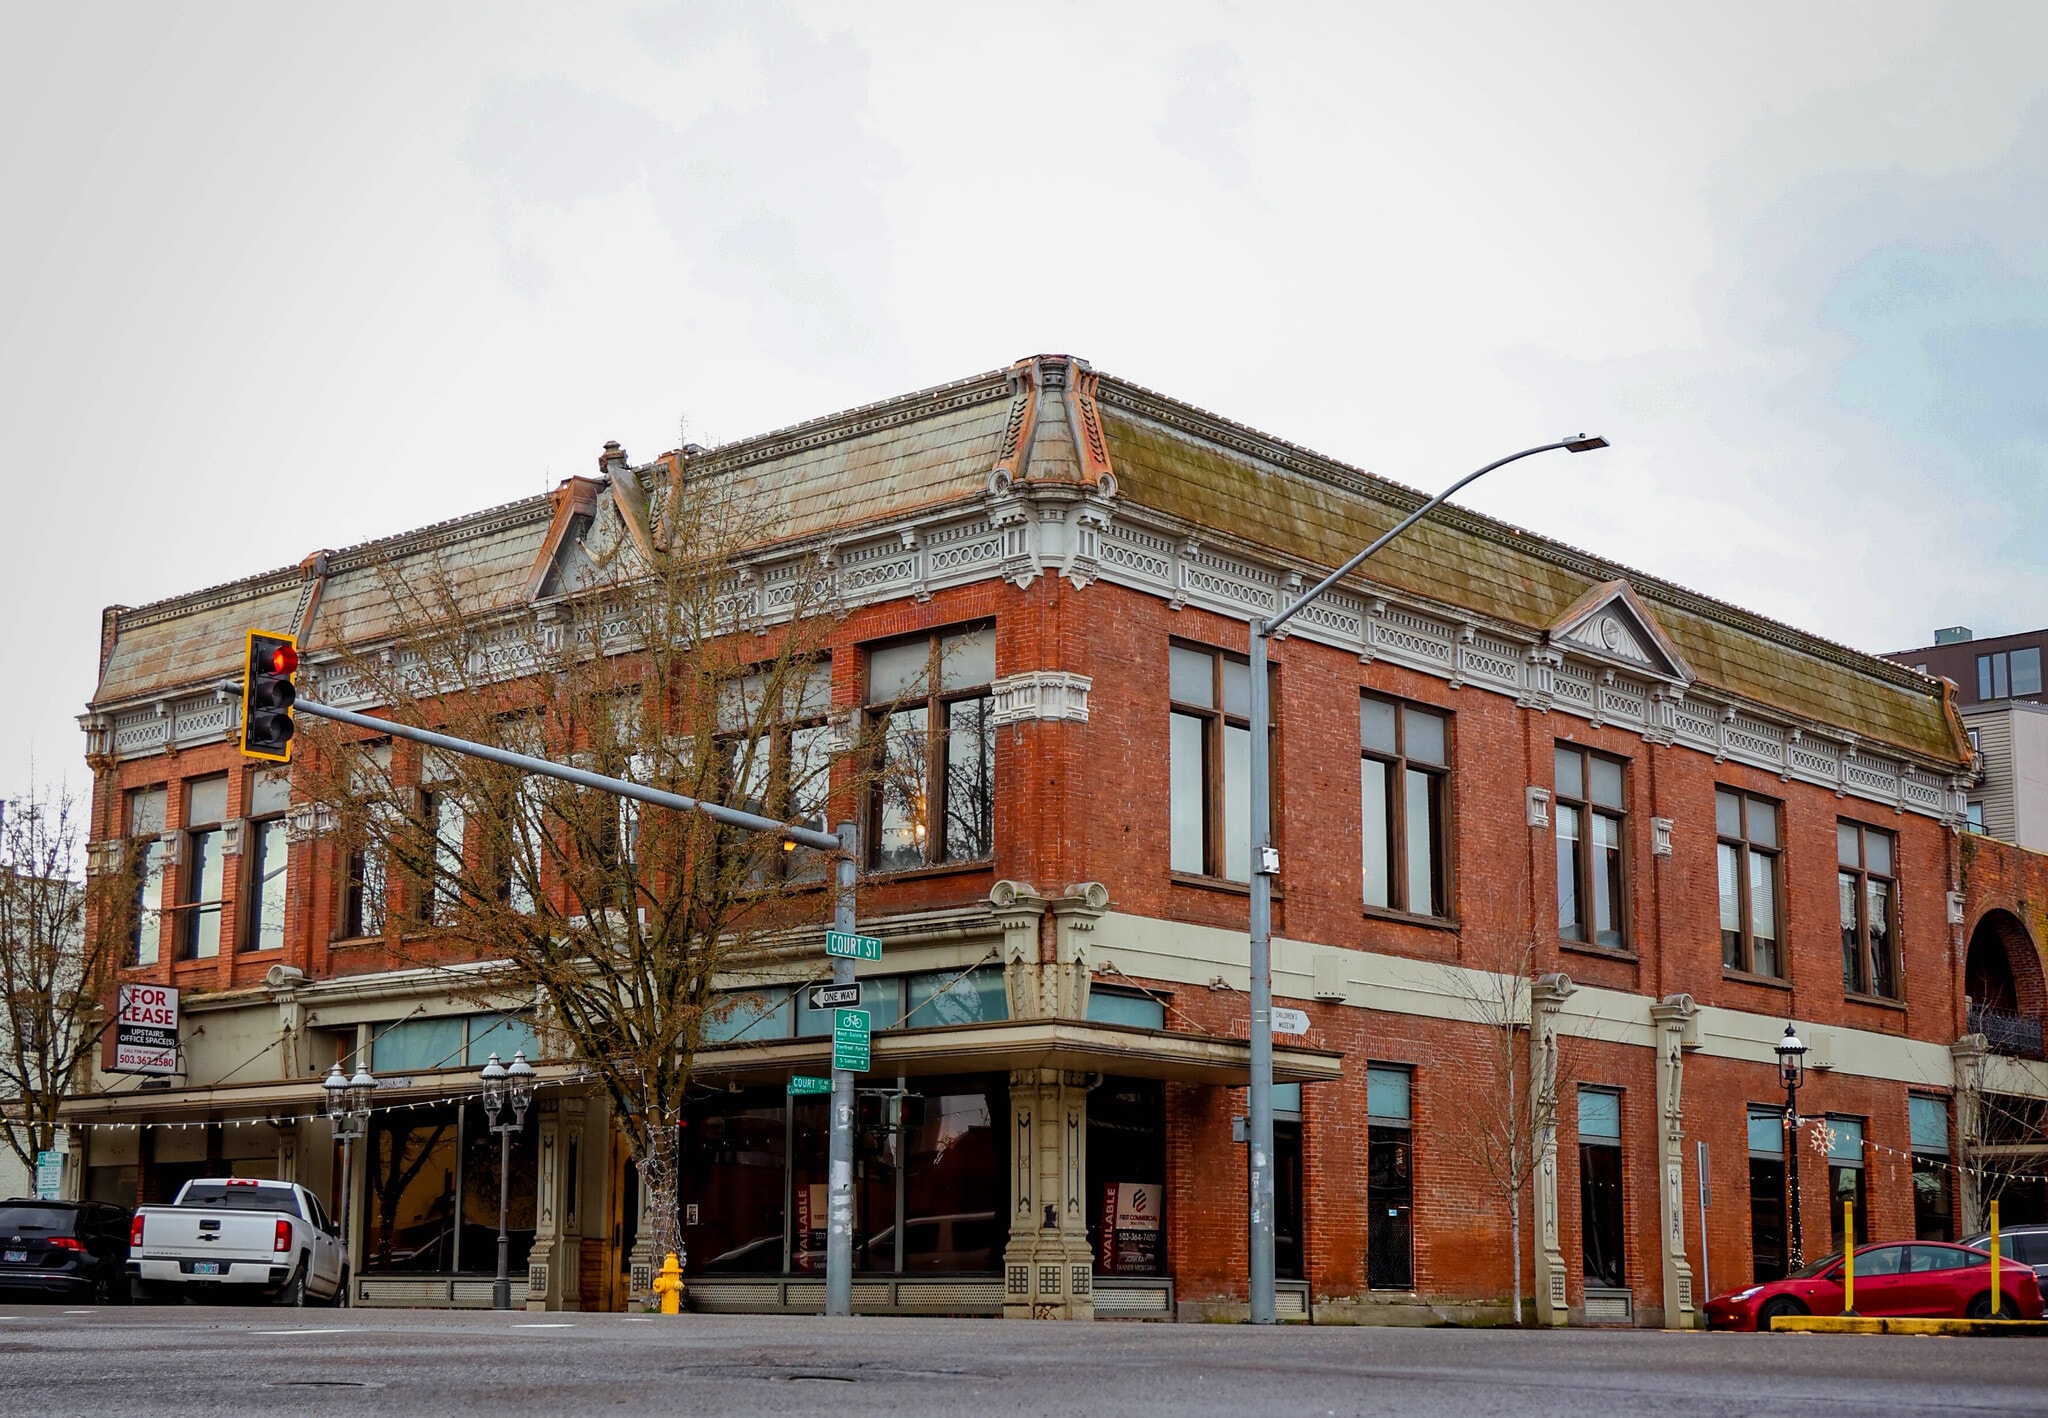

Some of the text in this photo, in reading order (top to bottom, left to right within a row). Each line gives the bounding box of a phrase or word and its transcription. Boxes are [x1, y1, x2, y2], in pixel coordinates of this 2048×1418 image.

[831, 934, 877, 958] COURT ST
[131, 988, 166, 1006] FOR
[824, 990, 855, 1002] ONE WAY
[122, 1006, 174, 1025] LEASE
[1278, 1021, 1295, 1029] MUSEUM
[131, 1028, 164, 1038] UPSTAIRS
[120, 1034, 175, 1046] OFFICE SPACE(S)
[119, 1054, 174, 1067] 503.362.2580
[793, 1077, 816, 1089] COURT
[798, 1190, 808, 1268] AVAILABLE
[1103, 1188, 1116, 1270] AVAILABLE
